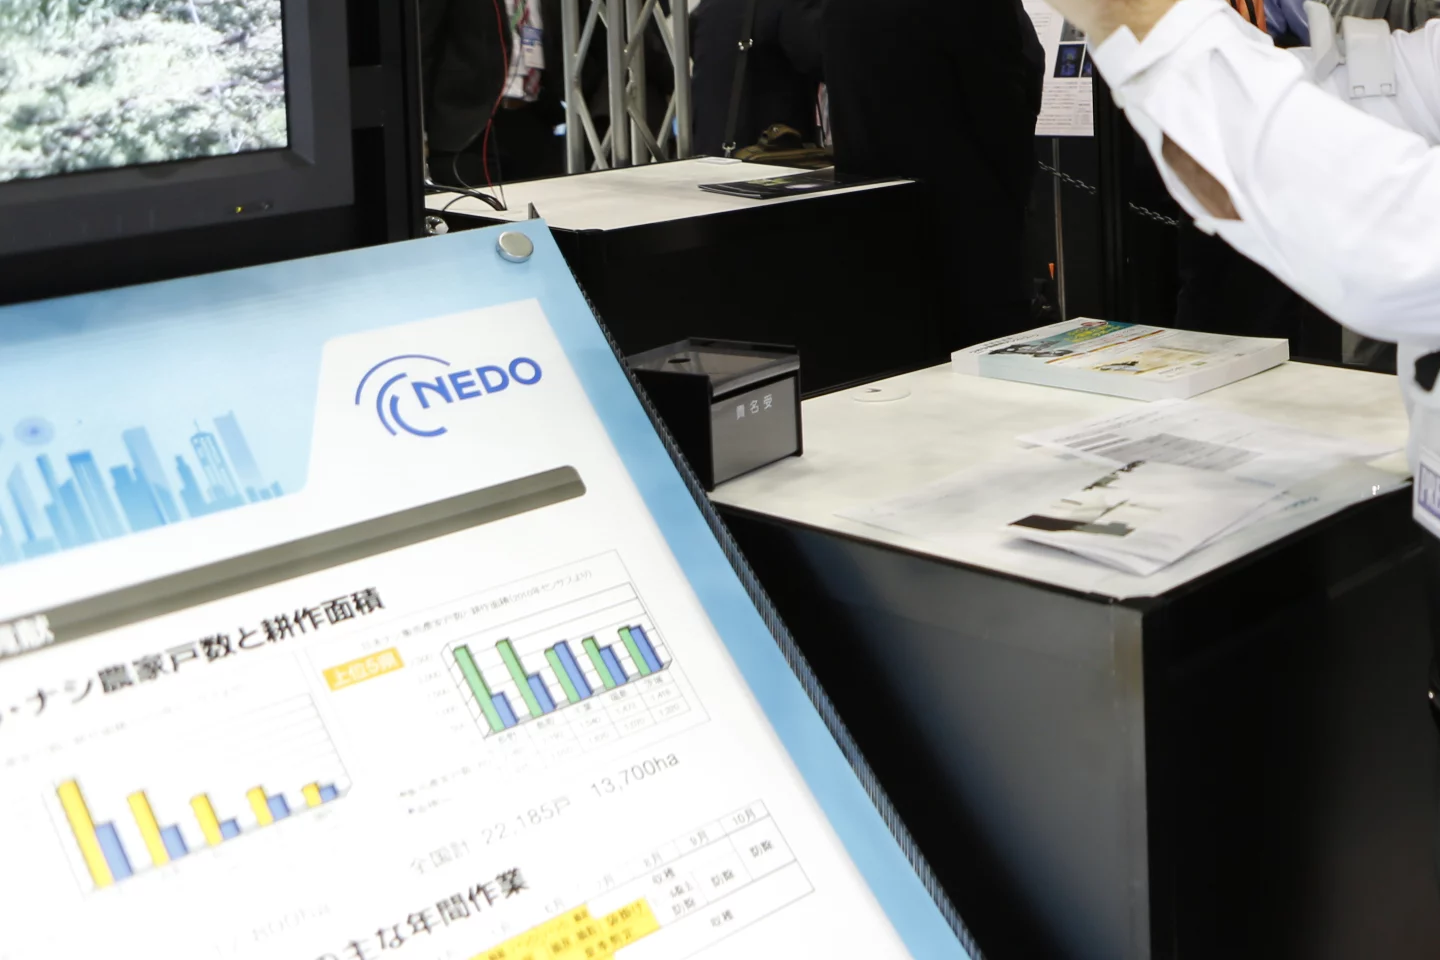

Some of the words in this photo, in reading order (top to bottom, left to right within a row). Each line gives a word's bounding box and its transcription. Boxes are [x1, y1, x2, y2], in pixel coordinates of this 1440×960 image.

[410, 356, 543, 410] NEDO
[0, 586, 386, 730] ・ナシ農家戸数と耕作面積
[591, 752, 680, 798] 13,700ha
